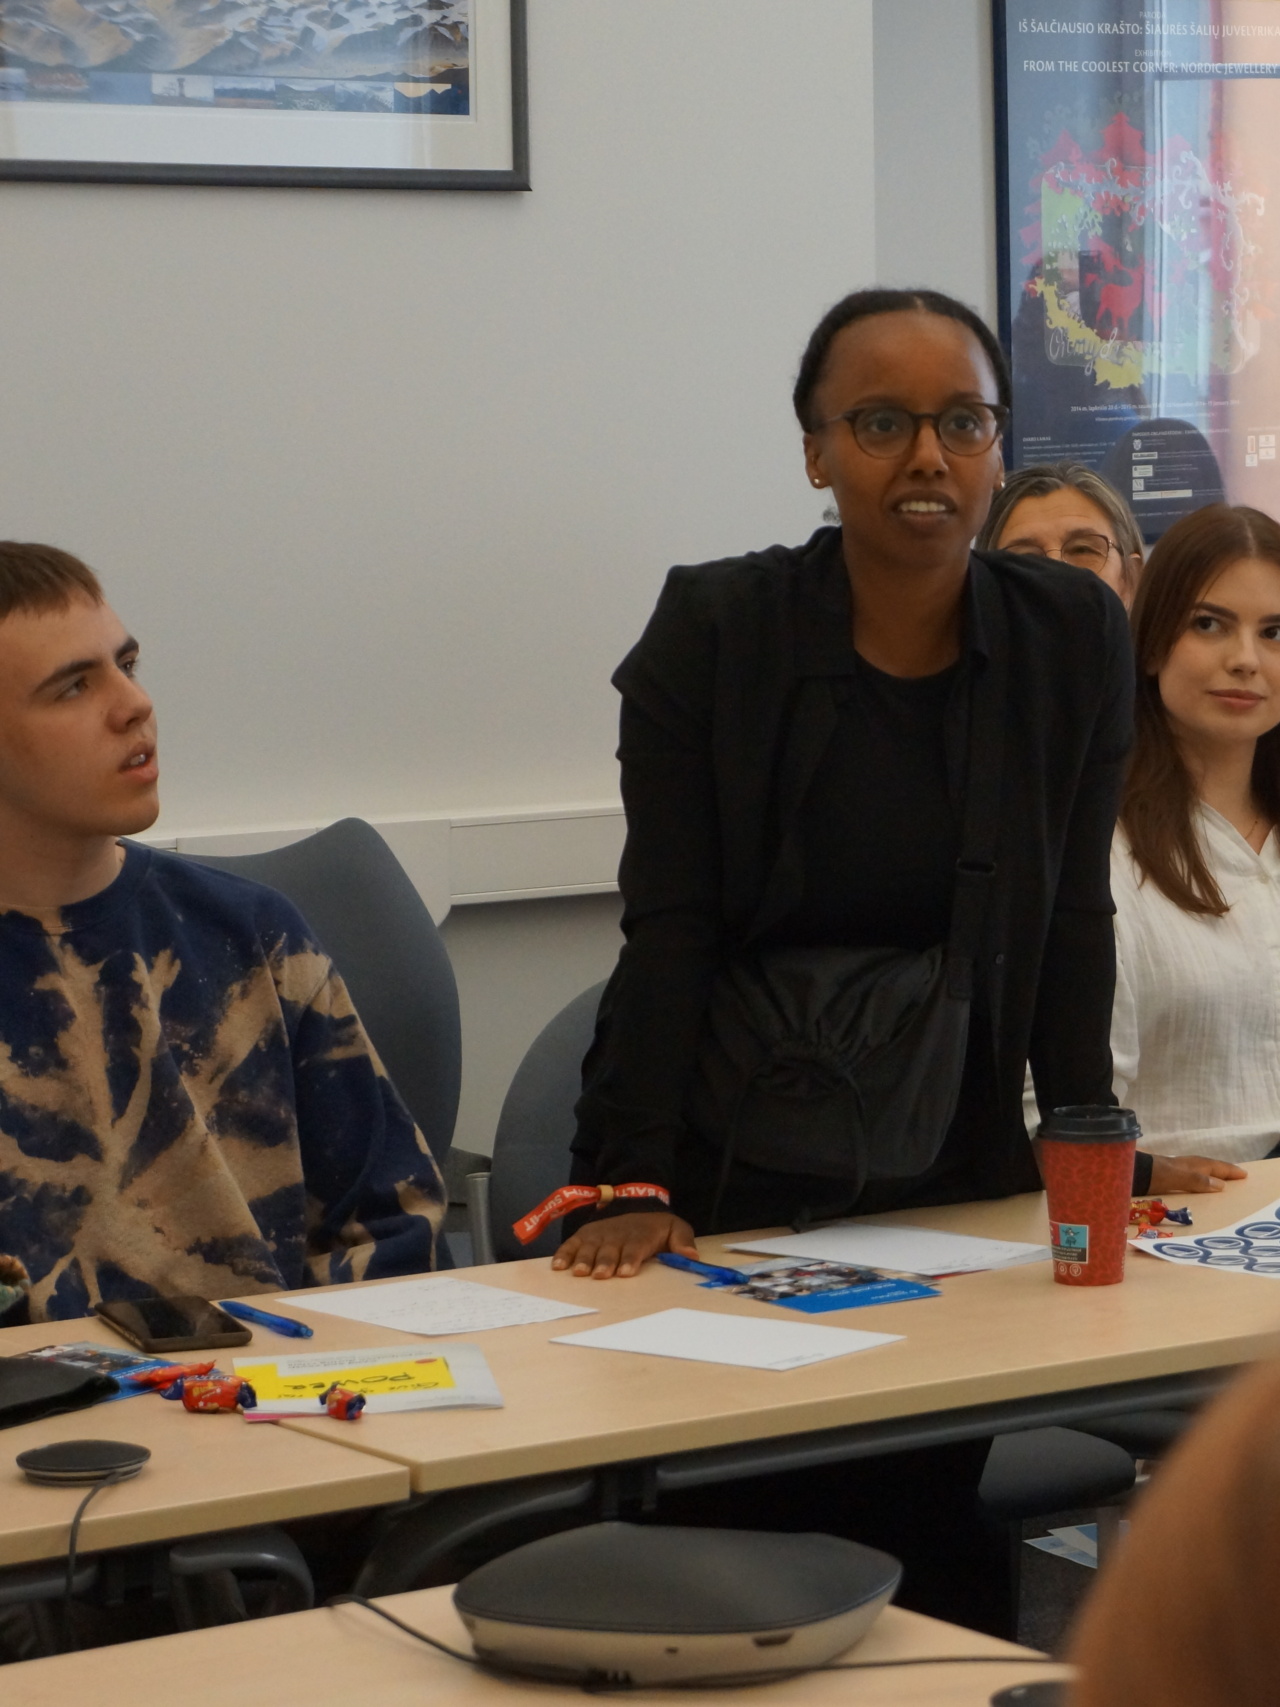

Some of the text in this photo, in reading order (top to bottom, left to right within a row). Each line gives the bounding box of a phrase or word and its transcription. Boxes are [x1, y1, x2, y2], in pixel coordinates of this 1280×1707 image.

[1018, 18, 1029, 33] IŠ
[1031, 18, 1095, 35] ŠALČIAUSIO
[1097, 21, 1143, 35] KRAŠTO:
[1145, 21, 1188, 36] ŠIAURĖS
[1190, 22, 1219, 39] ŠALIŲ
[1023, 60, 1278, 75] FROM THE COOLEST CORNER: NORDIC JEWELLERY
